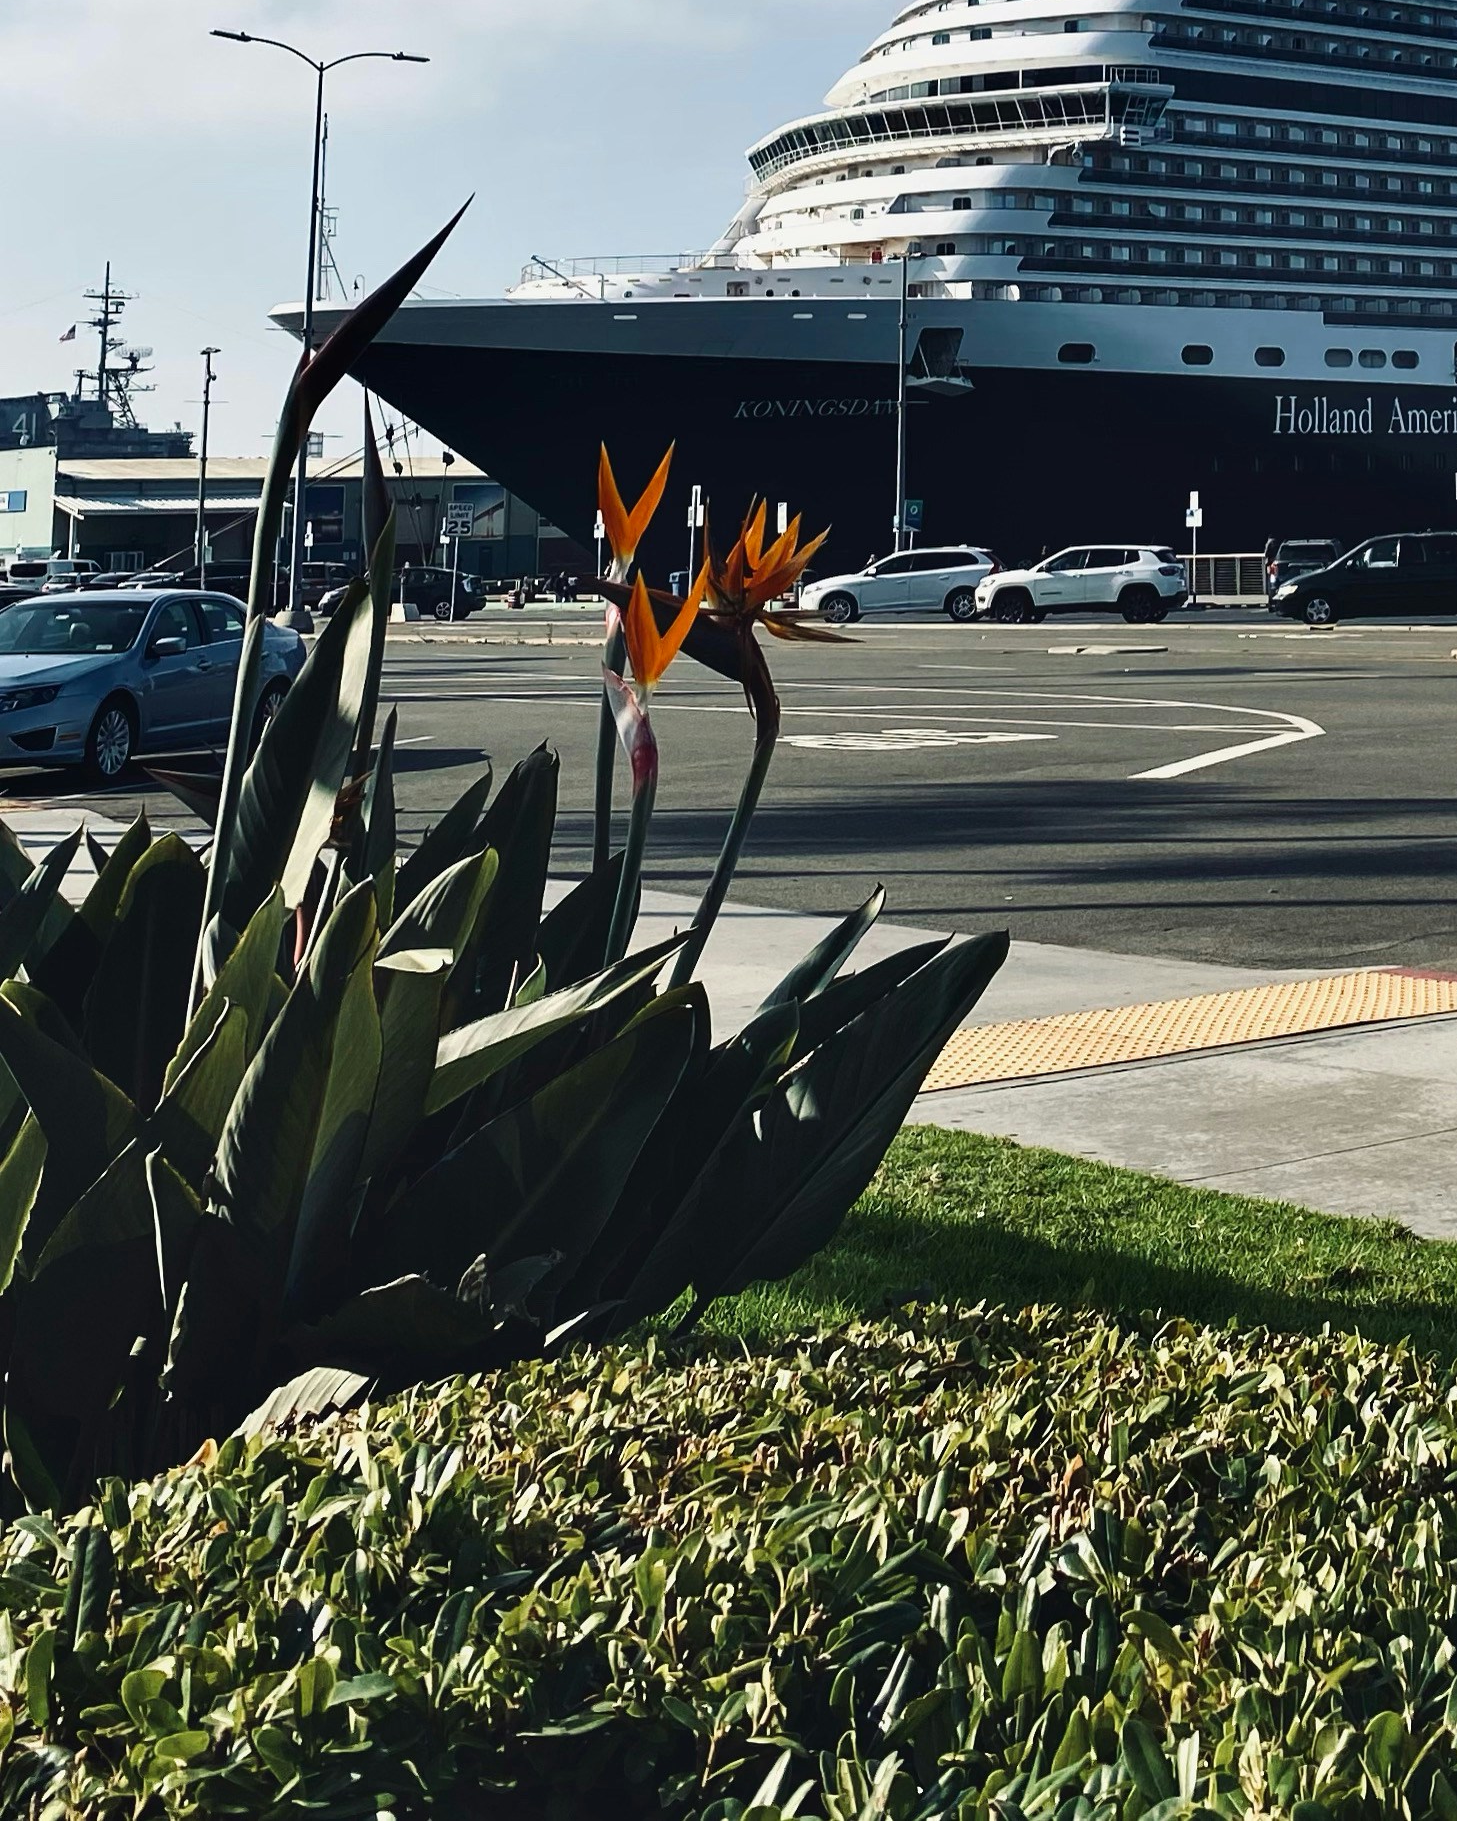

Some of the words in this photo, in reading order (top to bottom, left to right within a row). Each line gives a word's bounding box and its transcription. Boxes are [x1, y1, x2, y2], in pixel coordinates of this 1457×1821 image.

[12, 412, 36, 441] 41
[1273, 395, 1373, 434] Holland
[448, 520, 471, 535] 25
